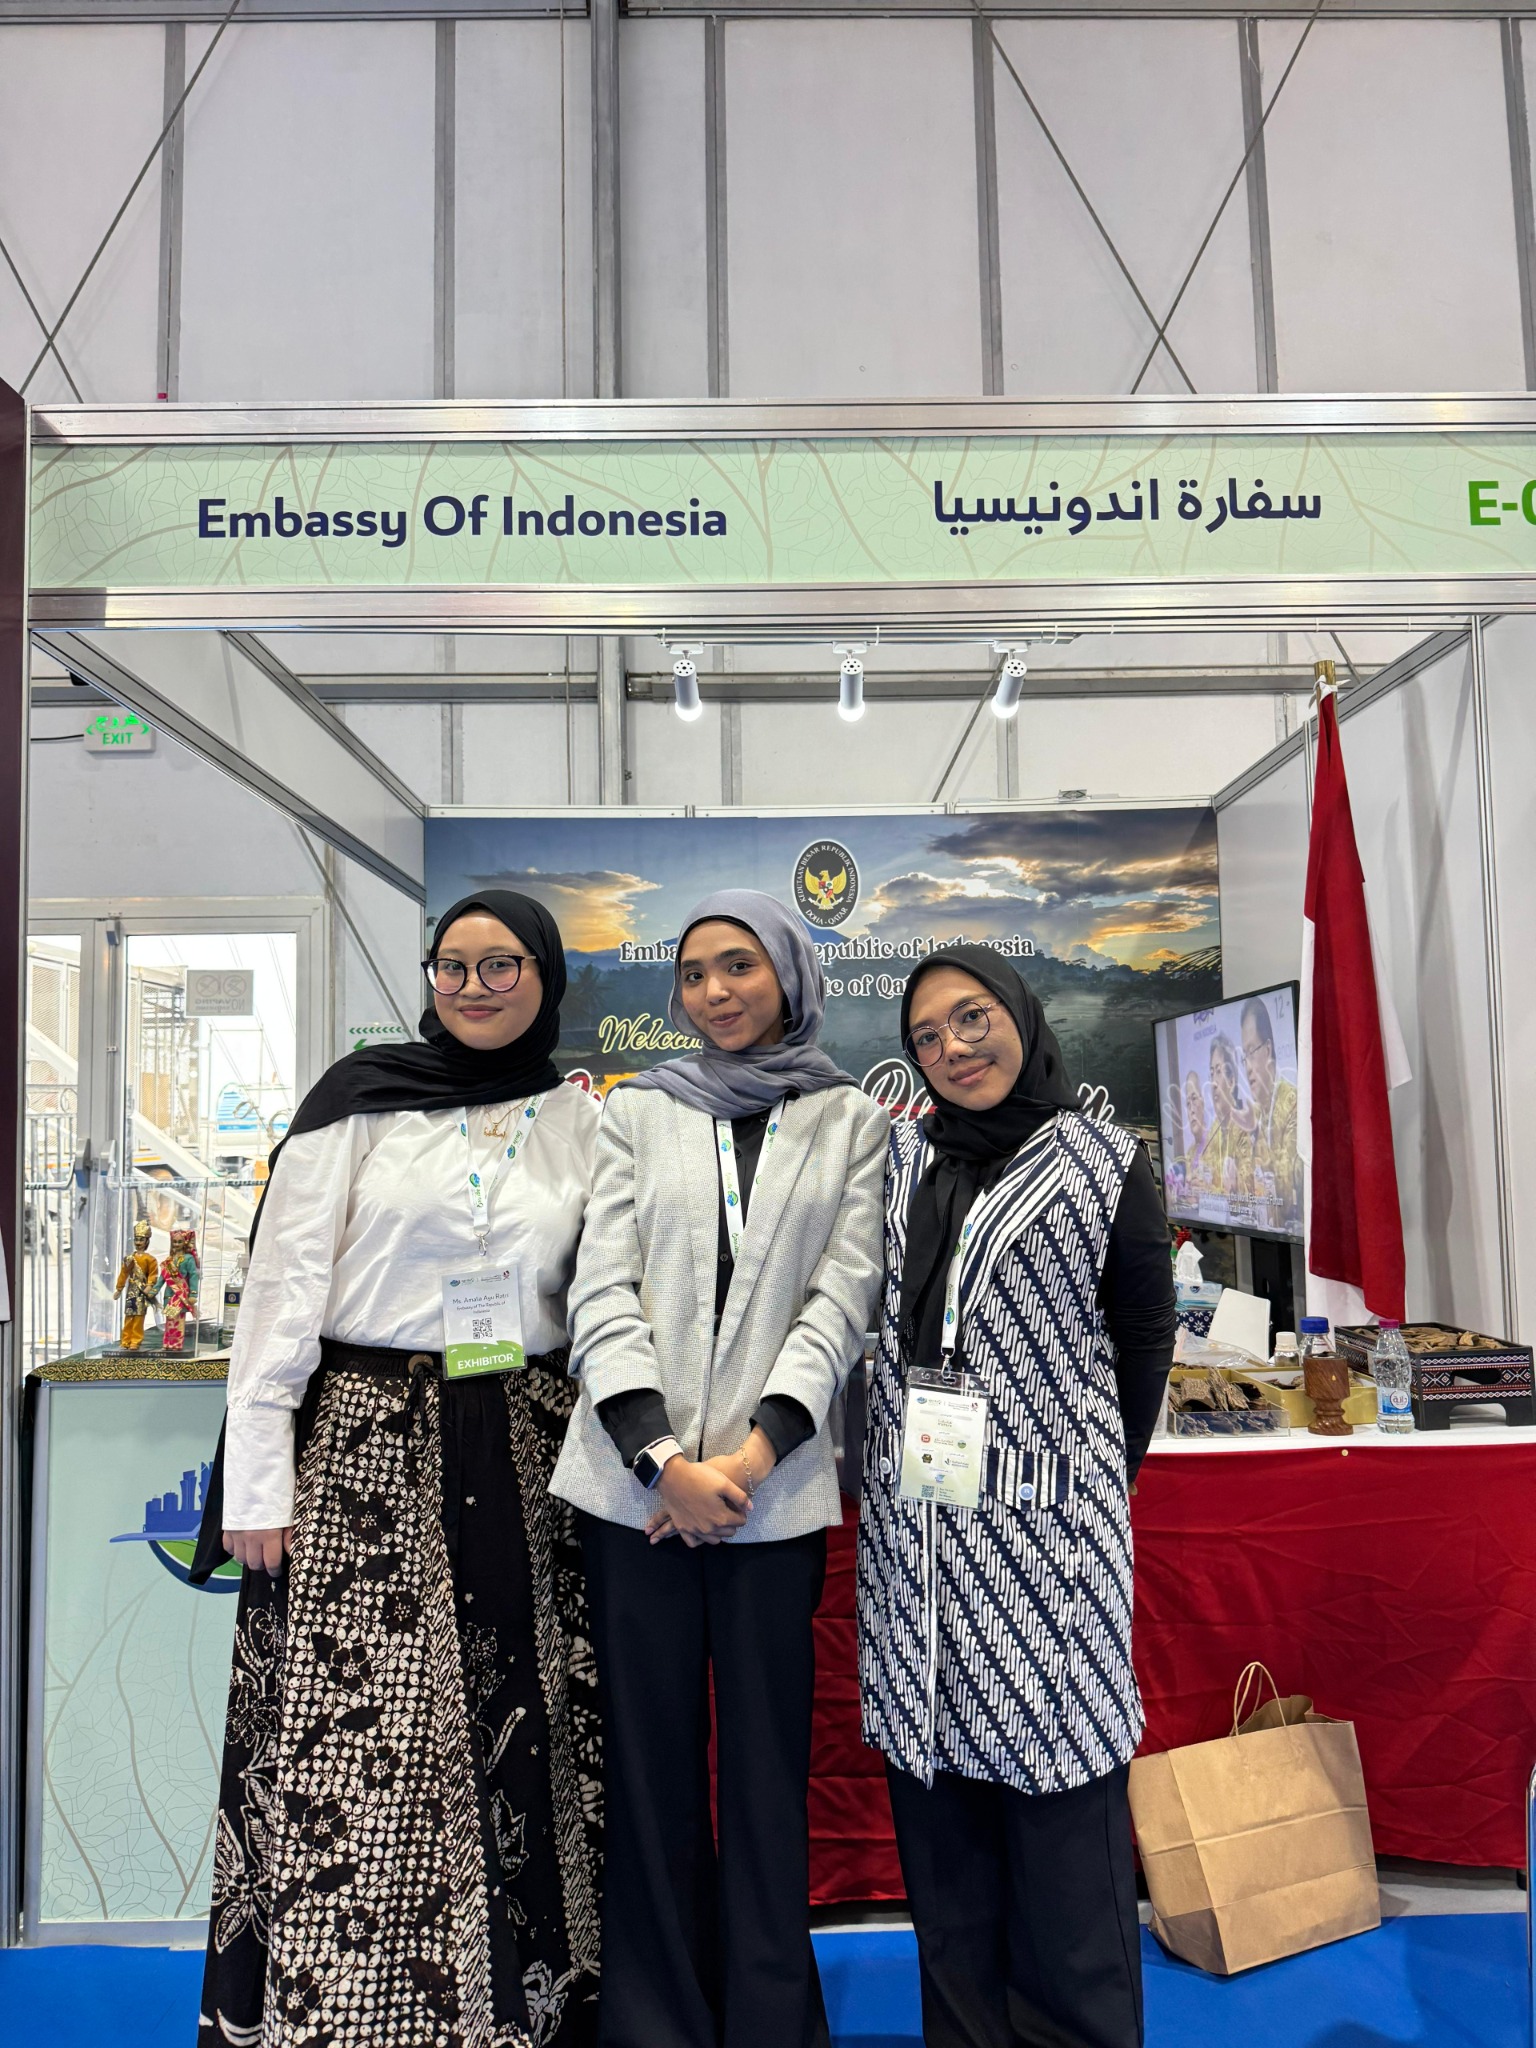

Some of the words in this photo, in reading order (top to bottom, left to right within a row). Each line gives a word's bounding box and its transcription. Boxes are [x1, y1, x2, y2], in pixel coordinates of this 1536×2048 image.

[933, 478, 1160, 537] اندونيسيا
[1178, 477, 1322, 534] سفارة
[198, 494, 407, 548] Embassy
[422, 493, 491, 537] Of
[503, 494, 728, 538] Indonesia
[102, 732, 133, 745] EXIT
[801, 846, 820, 866] BESAR
[821, 844, 852, 868] REPUBLIK
[846, 866, 856, 904] INDONESIA
[805, 909, 824, 925] DOHA
[827, 906, 849, 925] QATAR
[619, 939, 677, 962] Emba
[813, 936, 894, 965] epublic
[898, 937, 923, 959] of
[848, 974, 874, 996] of
[457, 1352, 514, 1370] EXHIBITOR
